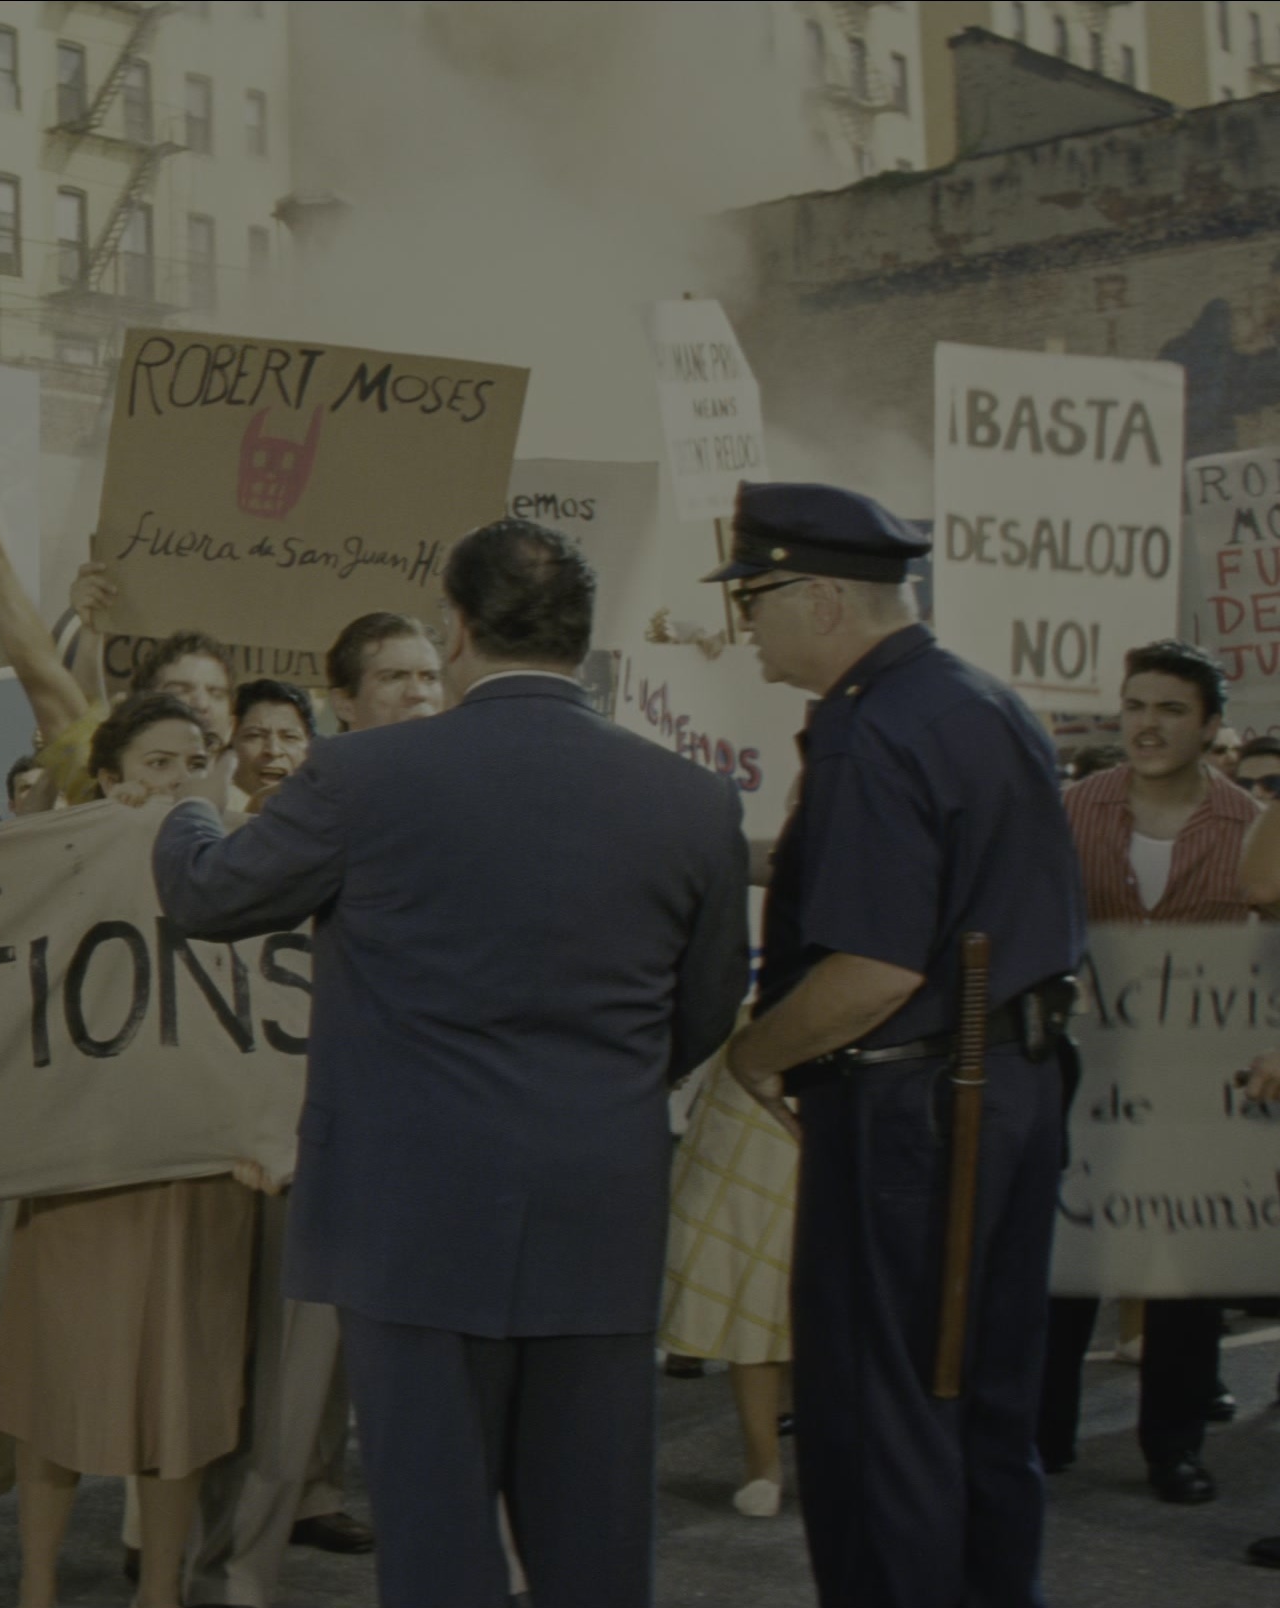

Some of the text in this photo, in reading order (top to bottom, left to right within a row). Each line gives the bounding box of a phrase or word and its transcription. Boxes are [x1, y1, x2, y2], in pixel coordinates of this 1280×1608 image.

[128, 337, 495, 423] ROBERT MOSES
[277, 536, 337, 569] San
[340, 536, 407, 579] Juan
[945, 512, 1172, 580] DESALOJO
[1010, 620, 1103, 682] NO!
[1076, 950, 1280, 1030] Activis
[1090, 1083, 1154, 1126] de
[1056, 1158, 1280, 1235] Comunid
